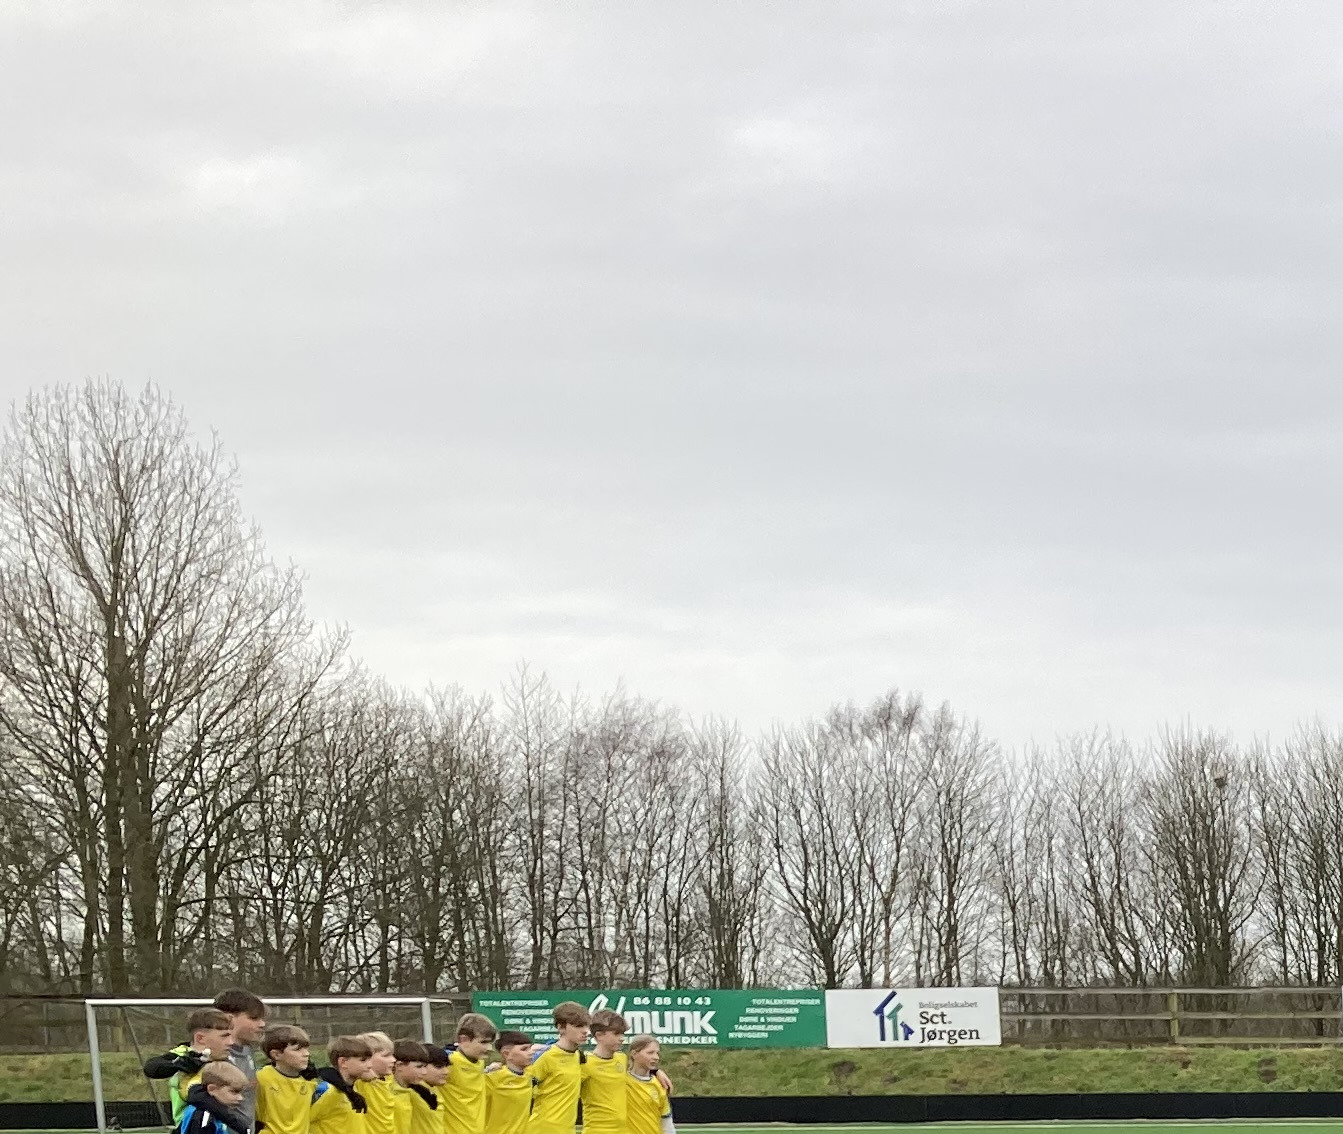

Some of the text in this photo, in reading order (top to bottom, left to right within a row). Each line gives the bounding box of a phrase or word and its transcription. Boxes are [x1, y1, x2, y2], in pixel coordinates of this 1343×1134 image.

[633, 996, 712, 1005] 86 88 10 43
[919, 1011, 953, 1025] Sct.
[659, 1036, 719, 1045] SNEDKER
[919, 1027, 981, 1045] Jørgen
